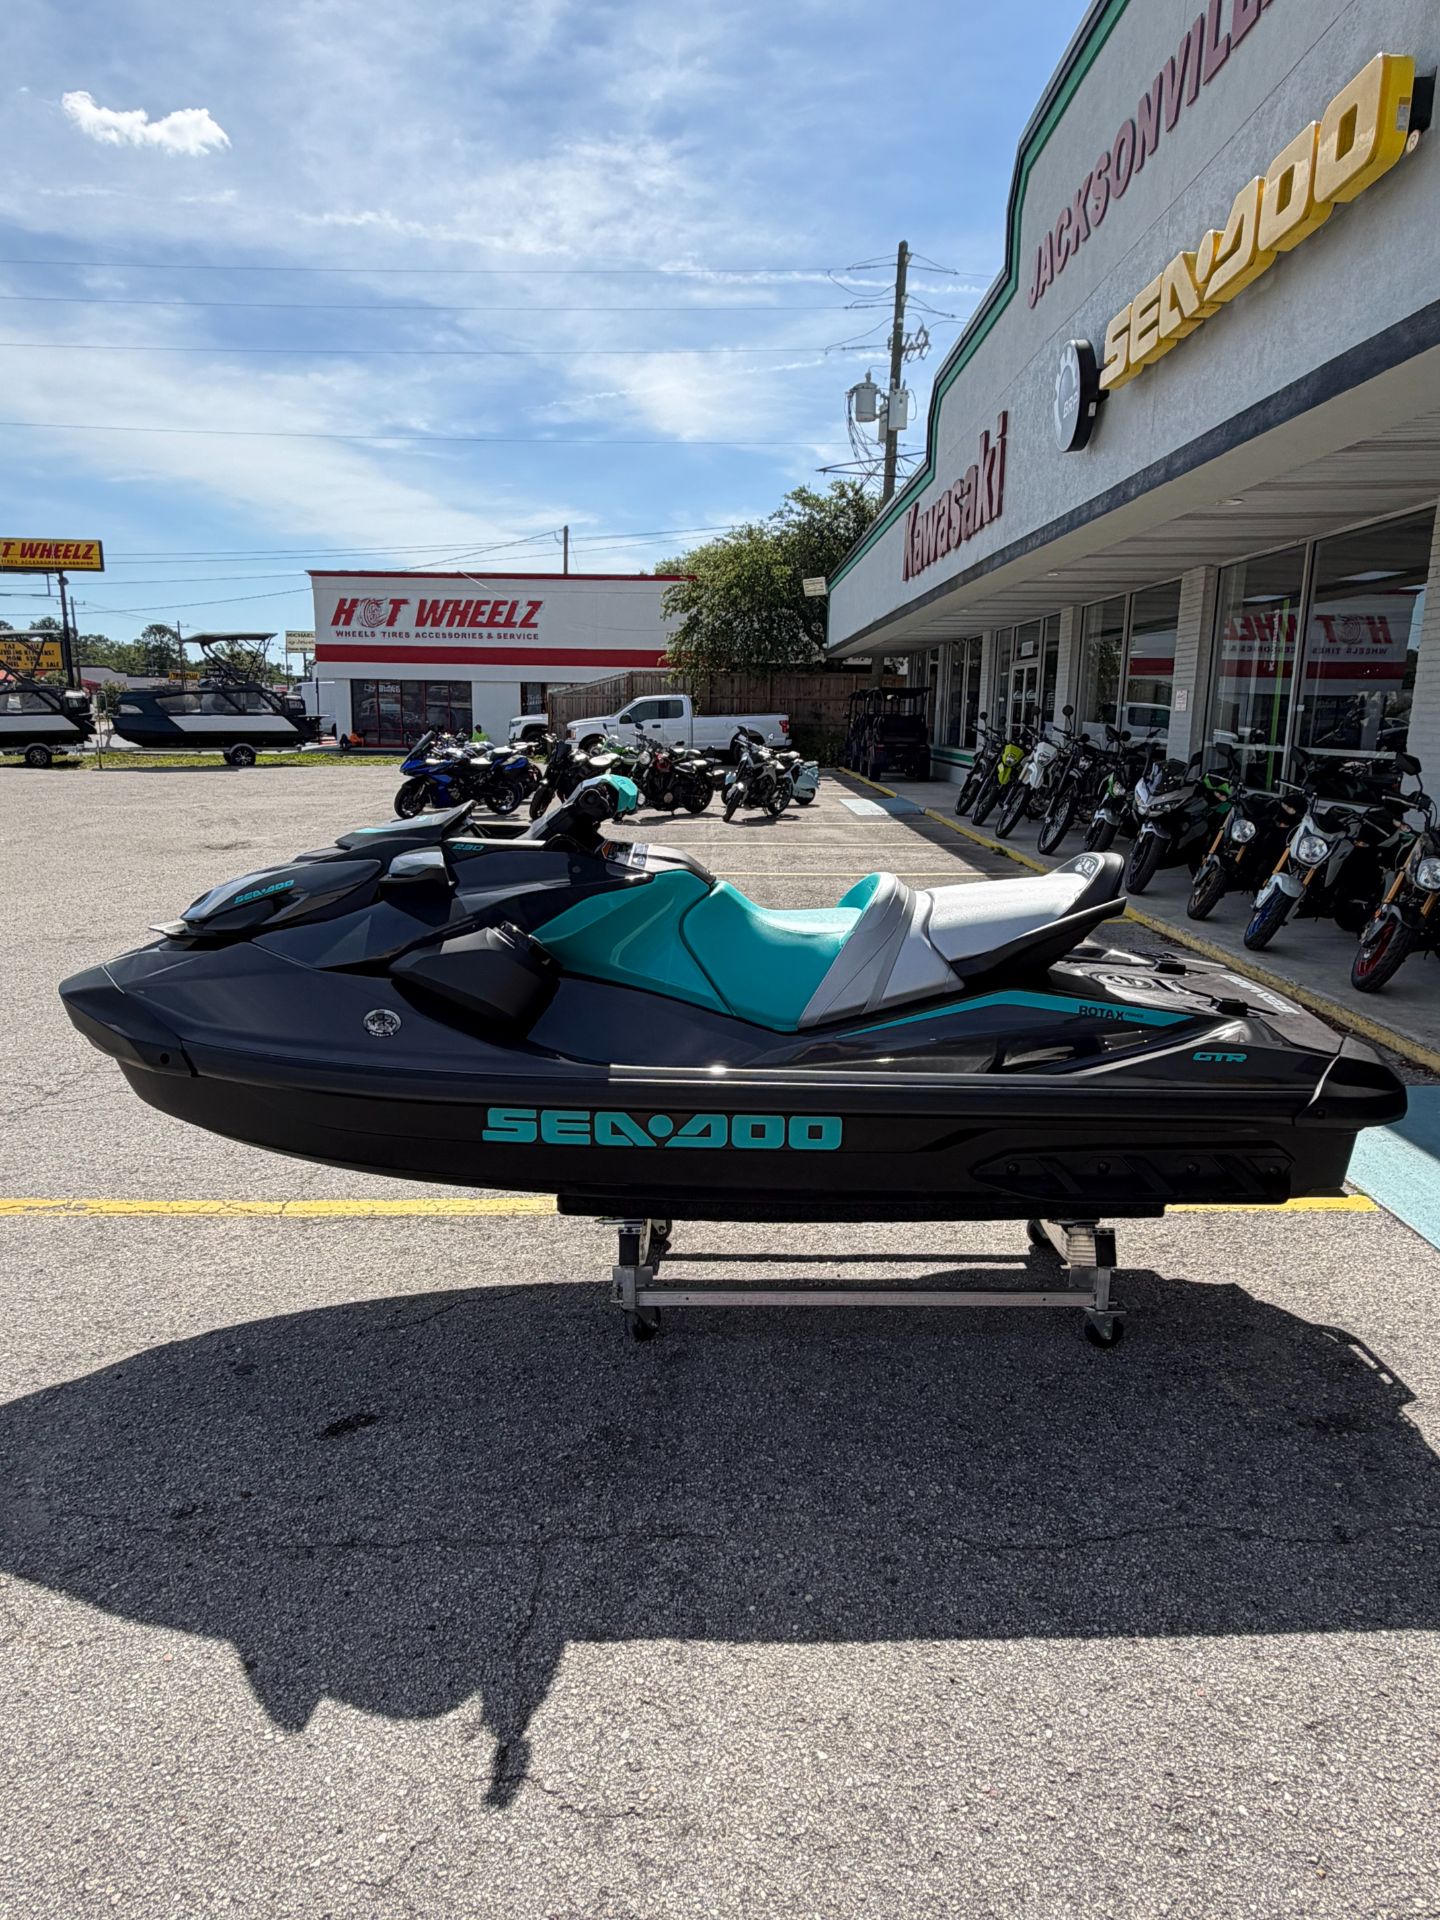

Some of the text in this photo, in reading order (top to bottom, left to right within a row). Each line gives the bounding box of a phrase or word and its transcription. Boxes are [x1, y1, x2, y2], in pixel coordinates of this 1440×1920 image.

[1028, 0, 1273, 309] JACKSONVILL
[1063, 391, 1078, 419] BRP
[903, 411, 1008, 581] Kawasaki
[19, 543, 95, 560] WHEELZ
[331, 597, 544, 629] HOT WHEELZ
[336, 630, 539, 641] WHEELS TIRES ACCESSORIES & SERVICE
[1079, 1000, 1124, 1020] ROTAX
[1193, 1051, 1248, 1063] GTR
